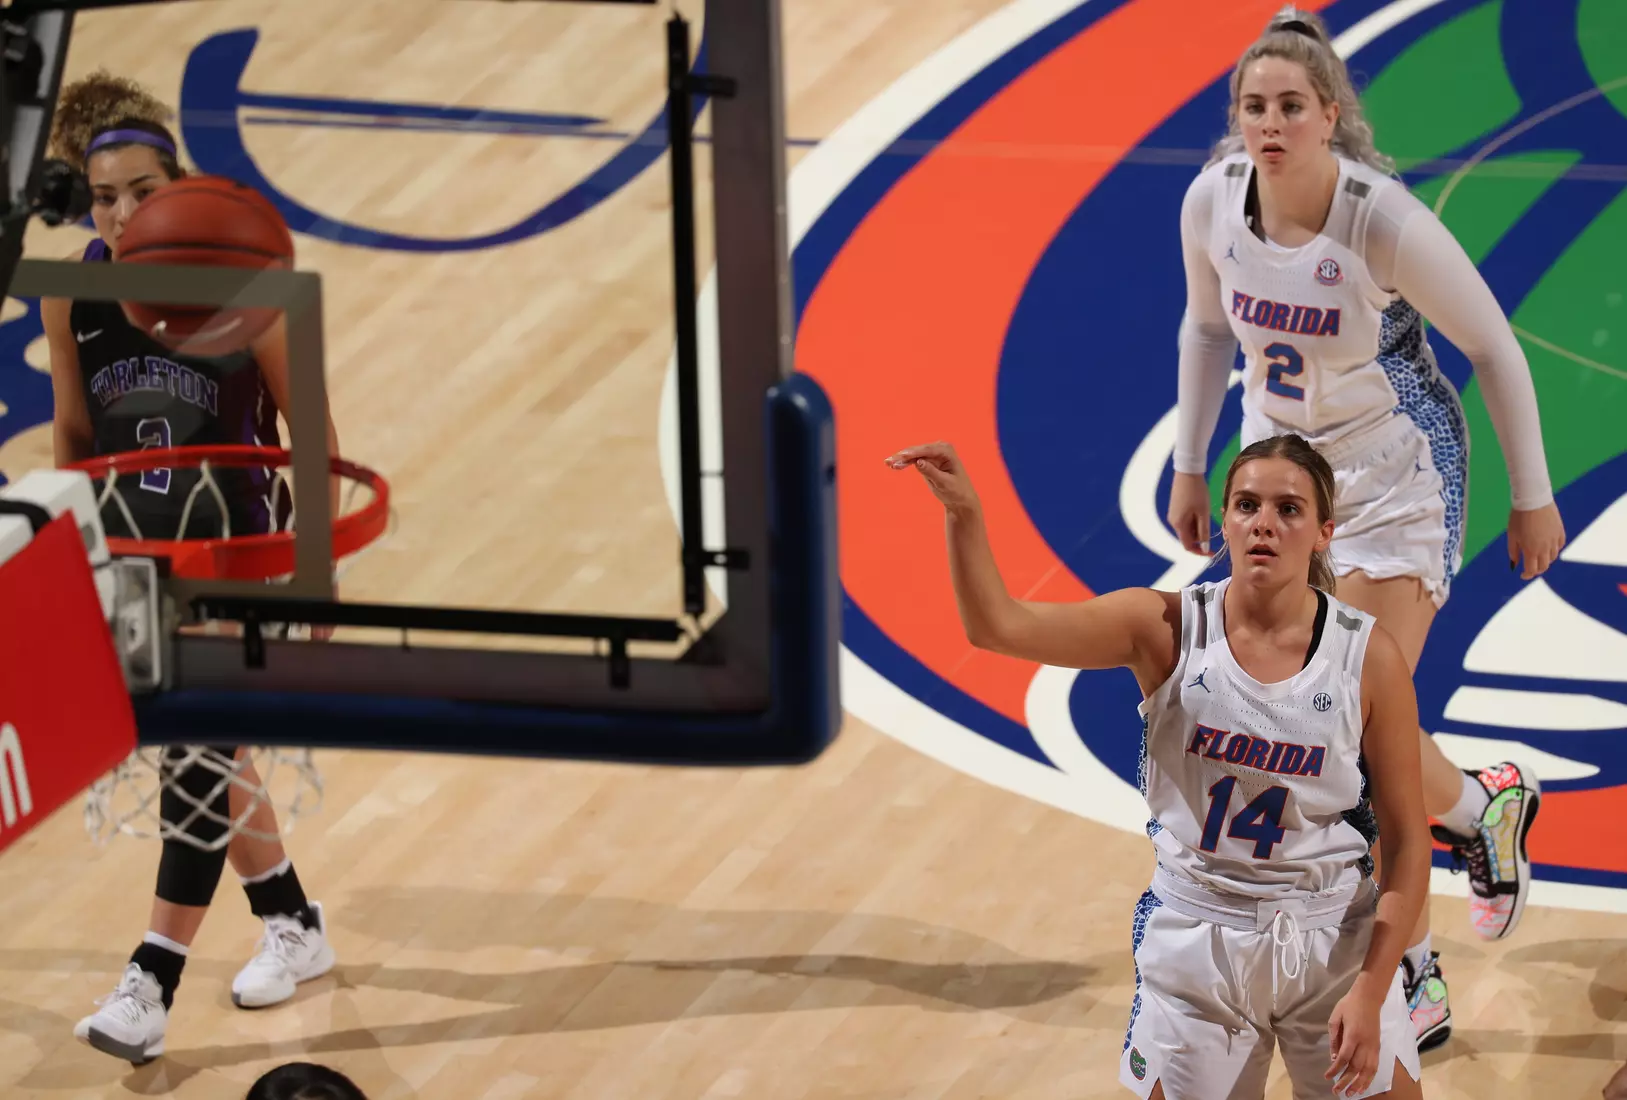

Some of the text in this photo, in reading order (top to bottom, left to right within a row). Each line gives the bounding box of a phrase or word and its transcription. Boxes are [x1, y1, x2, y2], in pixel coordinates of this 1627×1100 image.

[1319, 260, 1338, 279] SEC
[1232, 289, 1341, 336] FLORIDA
[91, 356, 219, 416] TARLETON
[1264, 342, 1304, 401] 2
[136, 417, 171, 494] 2
[1314, 693, 1331, 711] SEC
[1187, 723, 1326, 777] FLORIDA
[1200, 775, 1289, 860] 14
